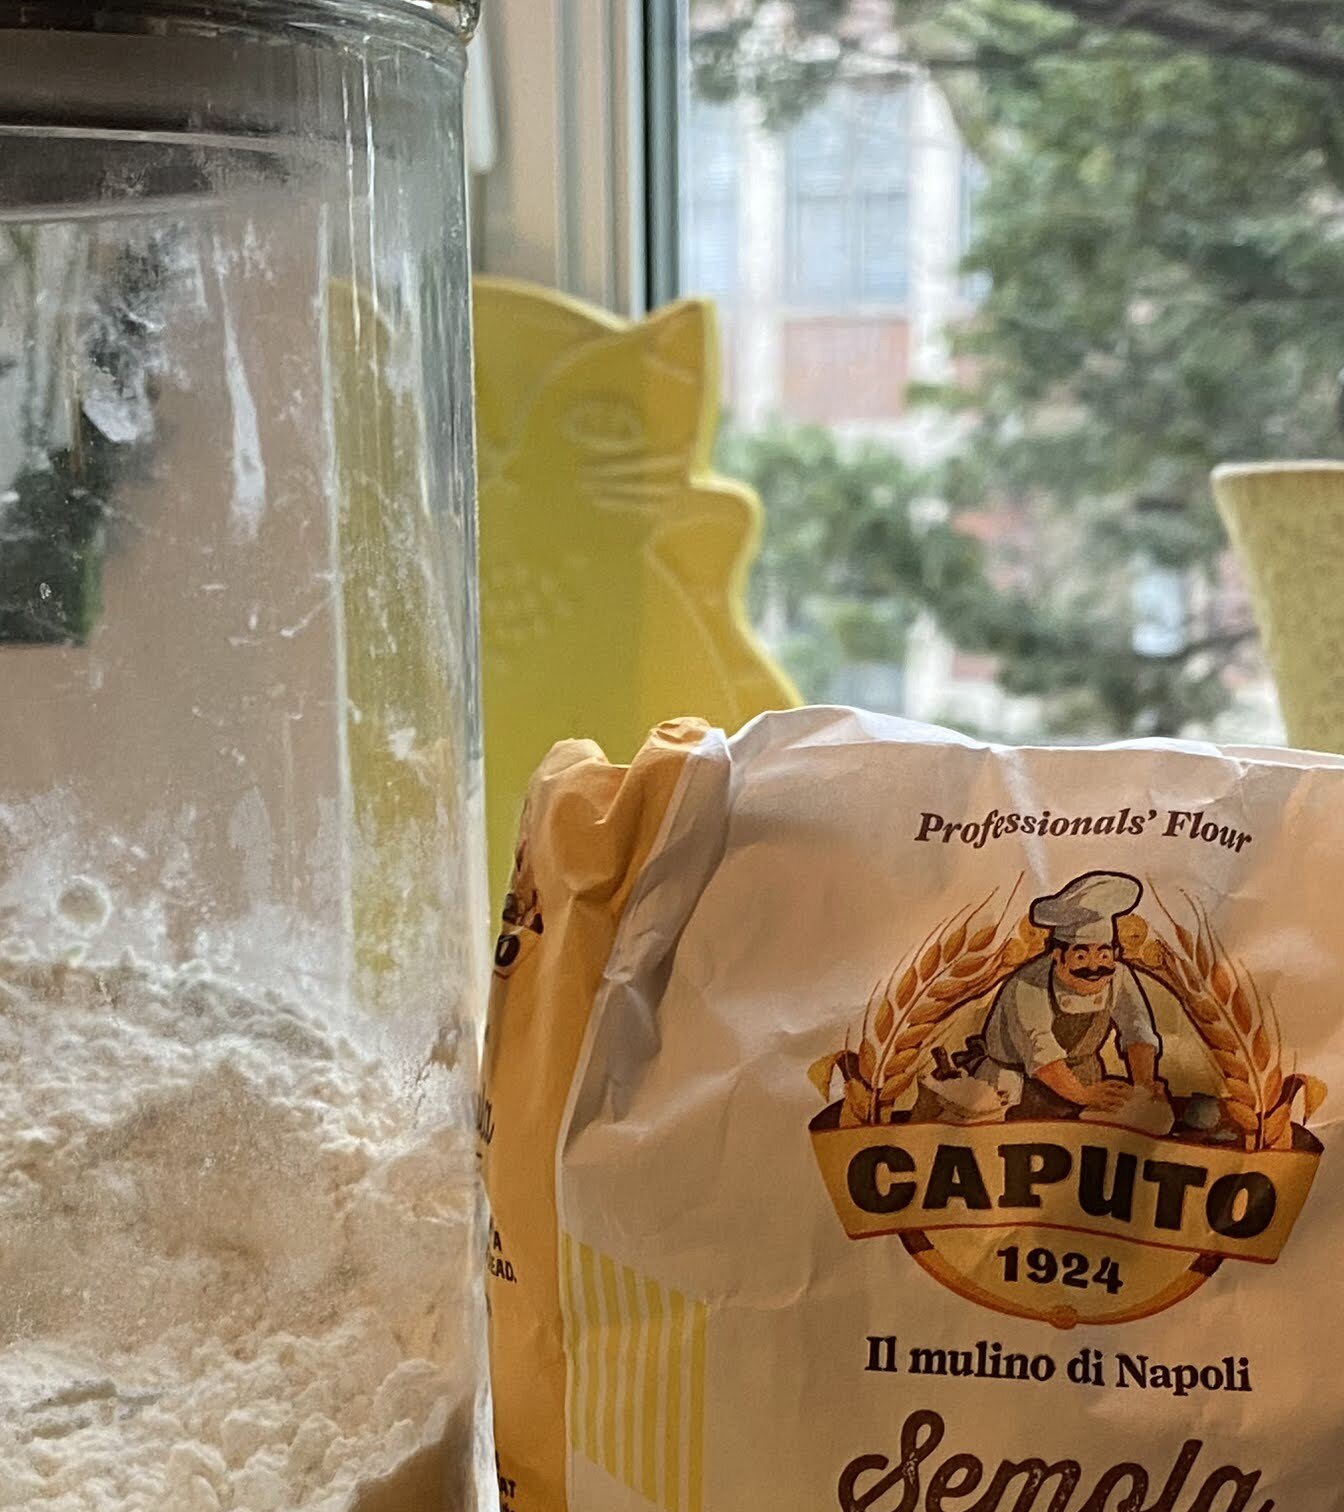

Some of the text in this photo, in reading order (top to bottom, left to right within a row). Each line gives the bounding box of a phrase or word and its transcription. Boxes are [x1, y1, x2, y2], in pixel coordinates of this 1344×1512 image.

[1162, 811, 1252, 854] Flour
[847, 1142, 1277, 1239] CAPUTO
[997, 1246, 1123, 1295] 1924
[865, 1336, 1252, 1397] Il mulino di Napoli
